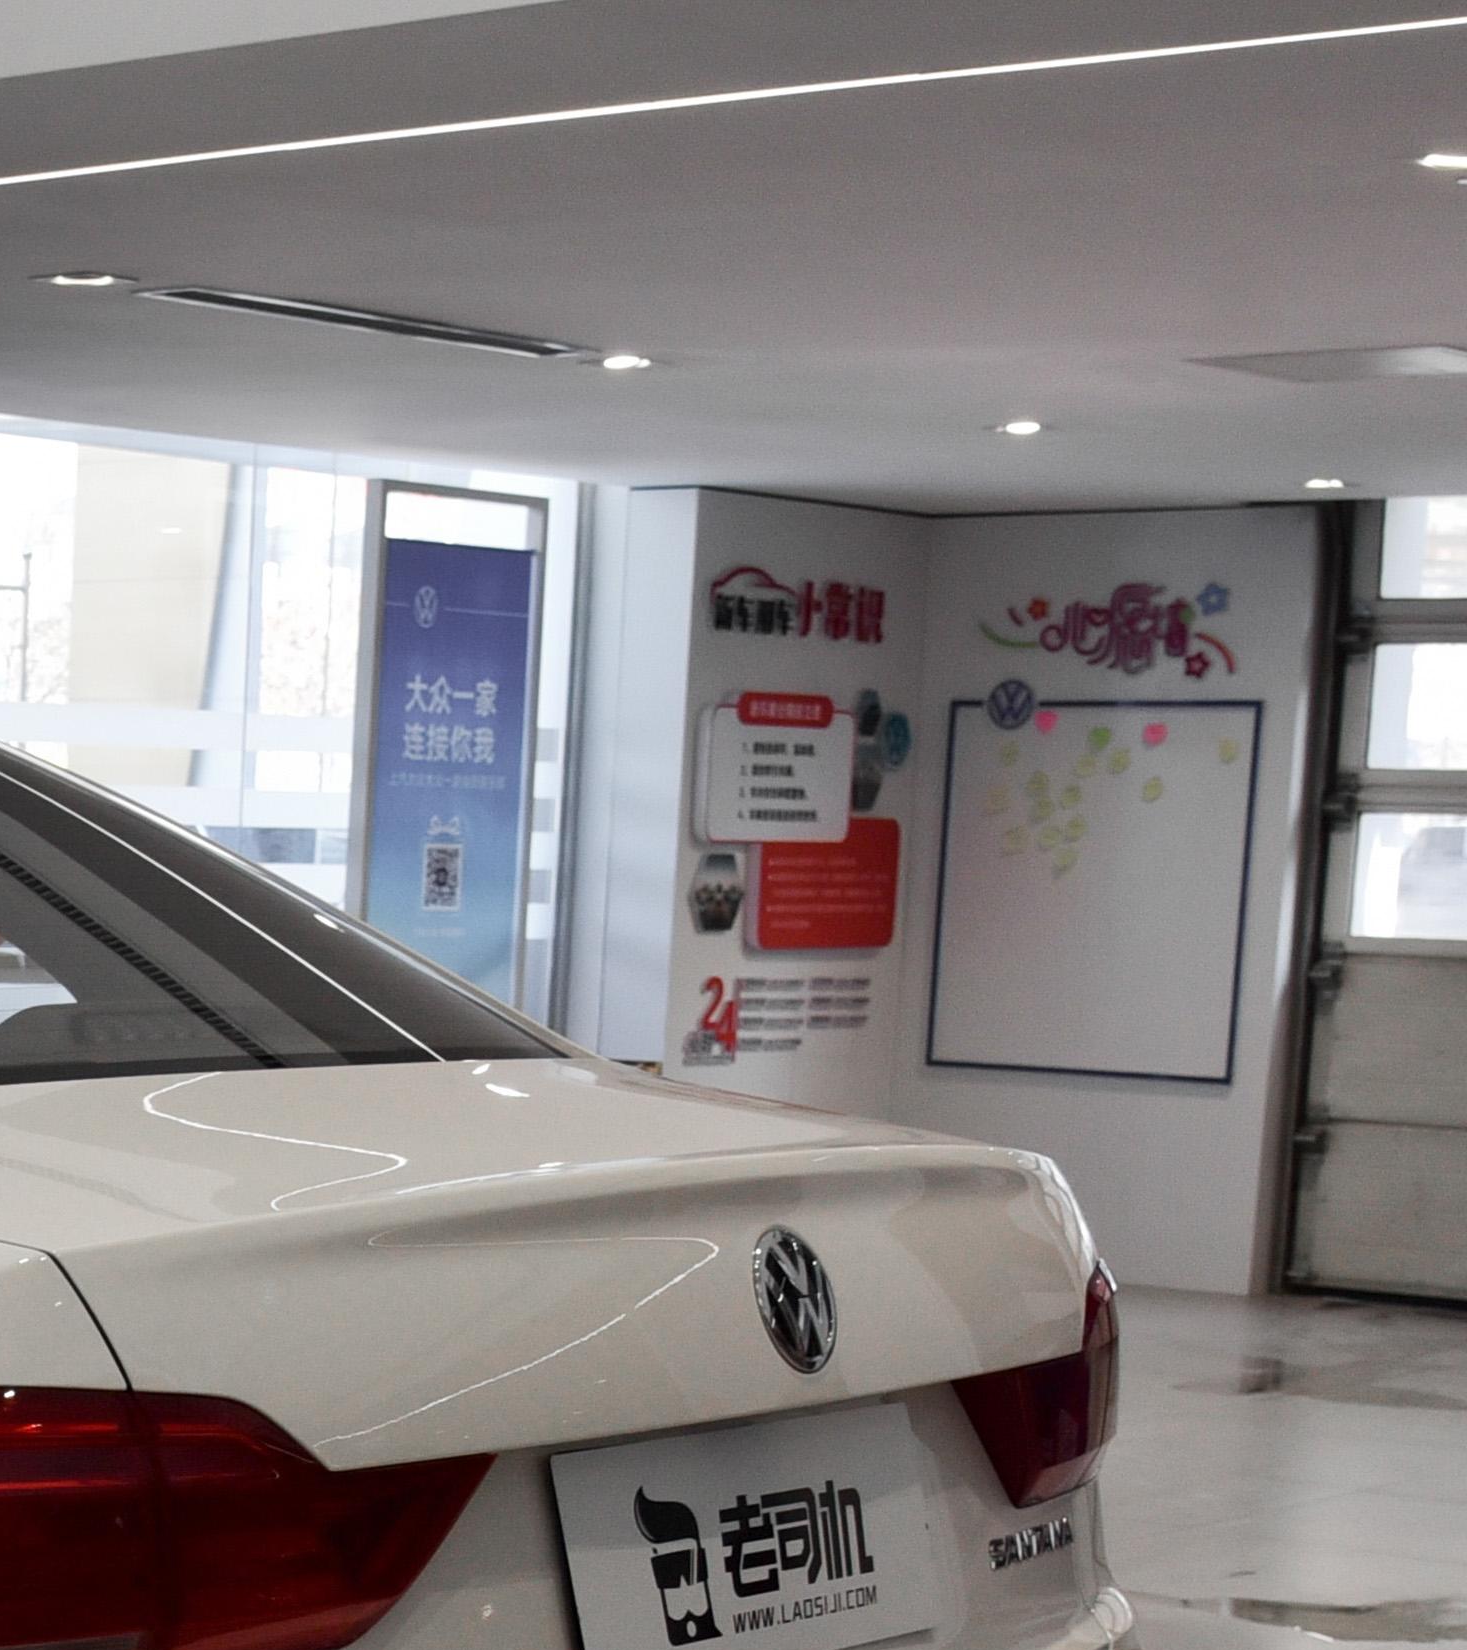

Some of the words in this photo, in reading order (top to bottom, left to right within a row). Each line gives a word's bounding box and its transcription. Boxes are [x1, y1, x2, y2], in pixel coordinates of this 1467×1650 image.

[405, 673, 499, 717] 大众一家
[403, 721, 496, 765] 连接你我
[719, 1480, 875, 1598] 老司机
[732, 1584, 878, 1635] WWW.LAOSIJI.COM
